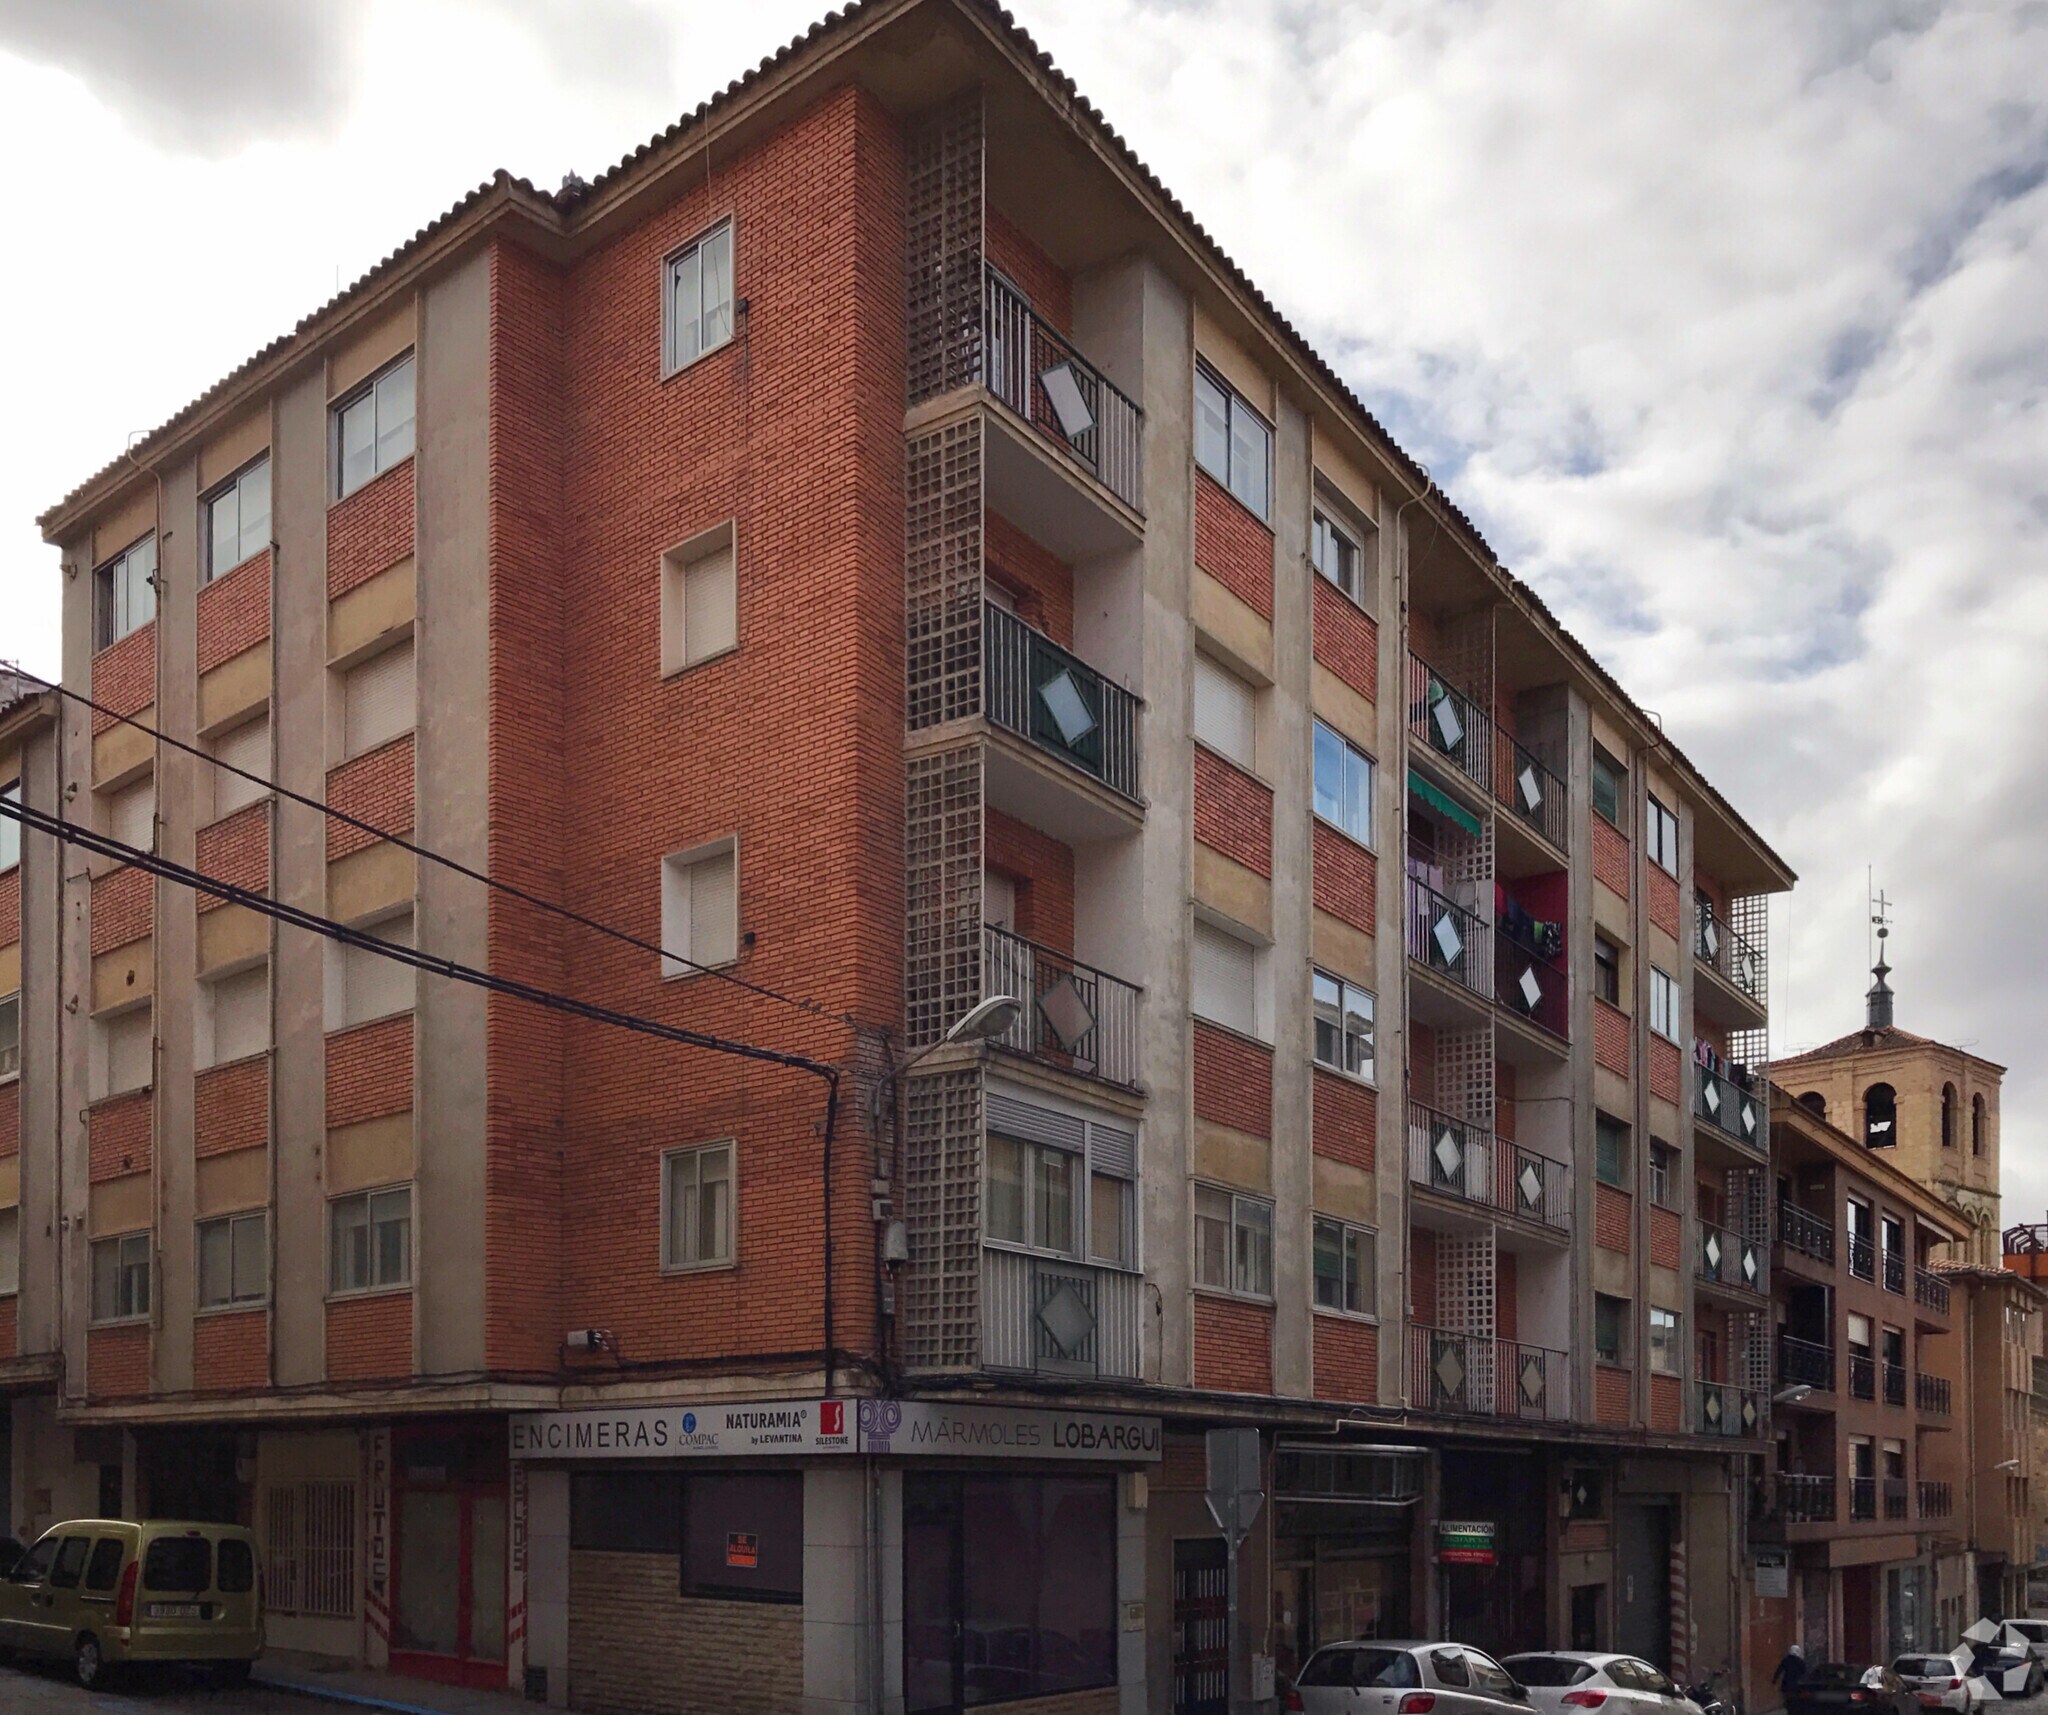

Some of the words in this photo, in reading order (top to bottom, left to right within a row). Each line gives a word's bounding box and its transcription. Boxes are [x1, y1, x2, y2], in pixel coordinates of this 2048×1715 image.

[513, 1420, 669, 1450] ENCIMERAS
[678, 1433, 719, 1446] COMPAC
[751, 1436, 759, 1445] by
[760, 1433, 803, 1444] LEVANTINA
[815, 1436, 849, 1445] SILESTONE
[1053, 1421, 1160, 1452] LOBARGUI
[1441, 1524, 1494, 1533] ALIMENTACIÓN
[729, 1543, 756, 1554] ALQUILA
